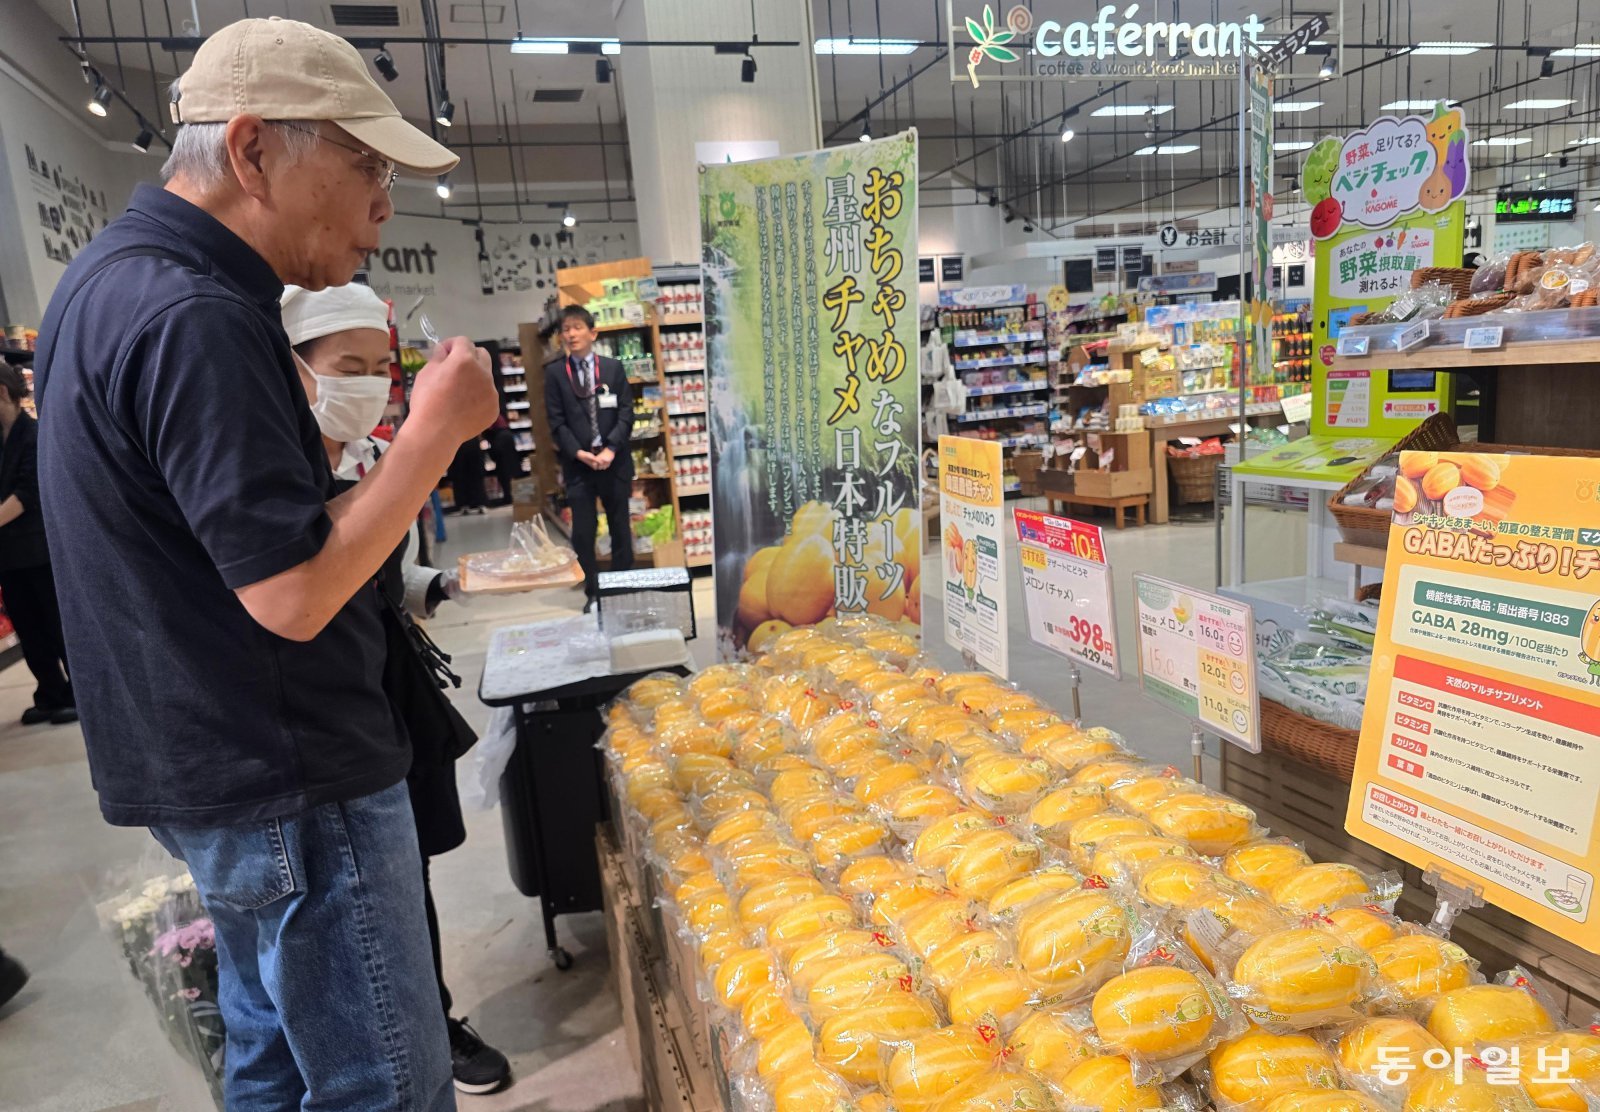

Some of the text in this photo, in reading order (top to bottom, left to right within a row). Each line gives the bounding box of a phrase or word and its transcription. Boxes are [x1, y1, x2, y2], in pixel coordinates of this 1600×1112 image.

[1035, 4, 1265, 57] caférrant
[1038, 59, 1240, 76] coffee & world food market
[1335, 151, 1429, 192] ベジチェック
[1365, 200, 1398, 215] KAGOME
[1185, 227, 1227, 247] お会計
[1339, 242, 1367, 258] あなたの
[1159, 616, 1185, 632] メロン
[1411, 610, 1457, 632] GABA
[1148, 647, 1175, 676] 15.0
[1400, 692, 1433, 710] ビタミンC
[1445, 675, 1544, 711] 天然のマルチサプリメント
[1396, 713, 1430, 732] ビタミンE
[1395, 737, 1423, 753] カリウム
[1372, 789, 1416, 816] お召し上がり方
